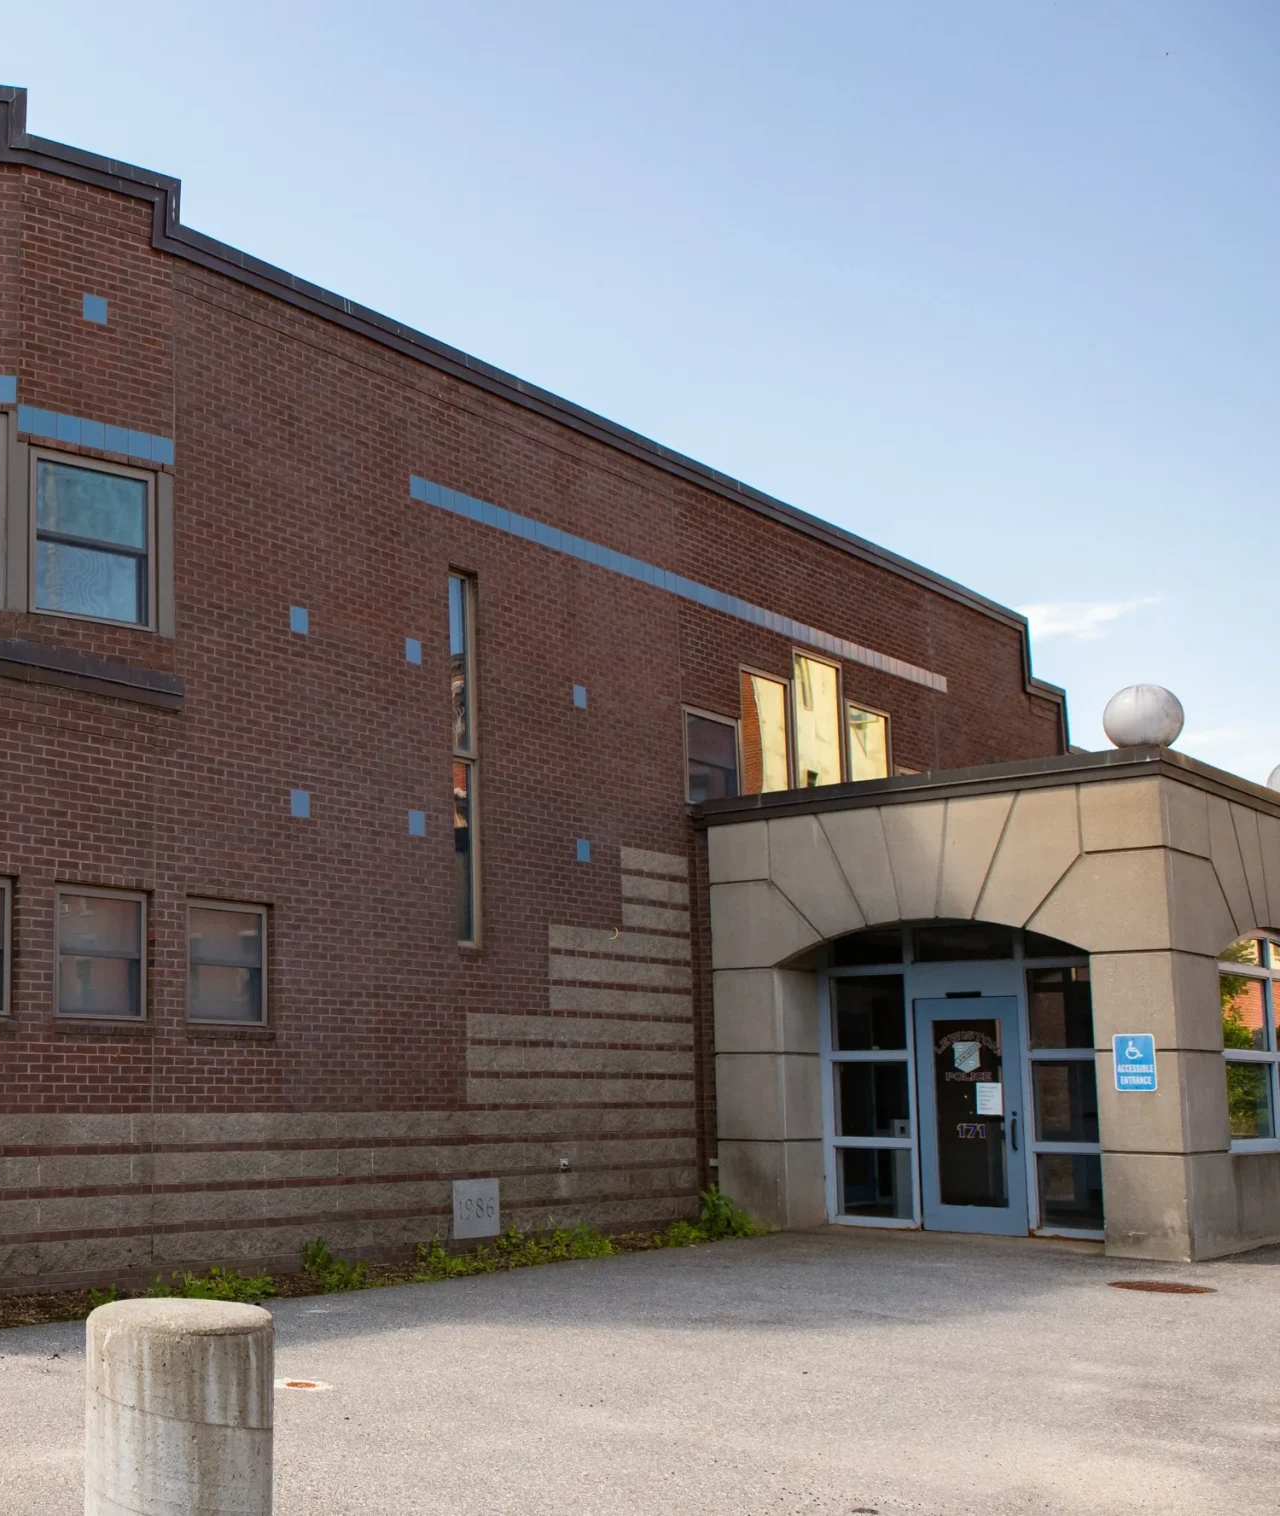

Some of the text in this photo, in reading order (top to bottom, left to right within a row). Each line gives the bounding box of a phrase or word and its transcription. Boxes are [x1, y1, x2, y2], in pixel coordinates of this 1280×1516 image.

[933, 1031, 1001, 1056] LEWISTON
[1117, 1064, 1154, 1073] ACCESSIBLE
[945, 1072, 992, 1081] POLICE
[1120, 1076, 1152, 1084] ENTRANCE
[956, 1123, 986, 1138] 171
[459, 1197, 495, 1220] 1986
